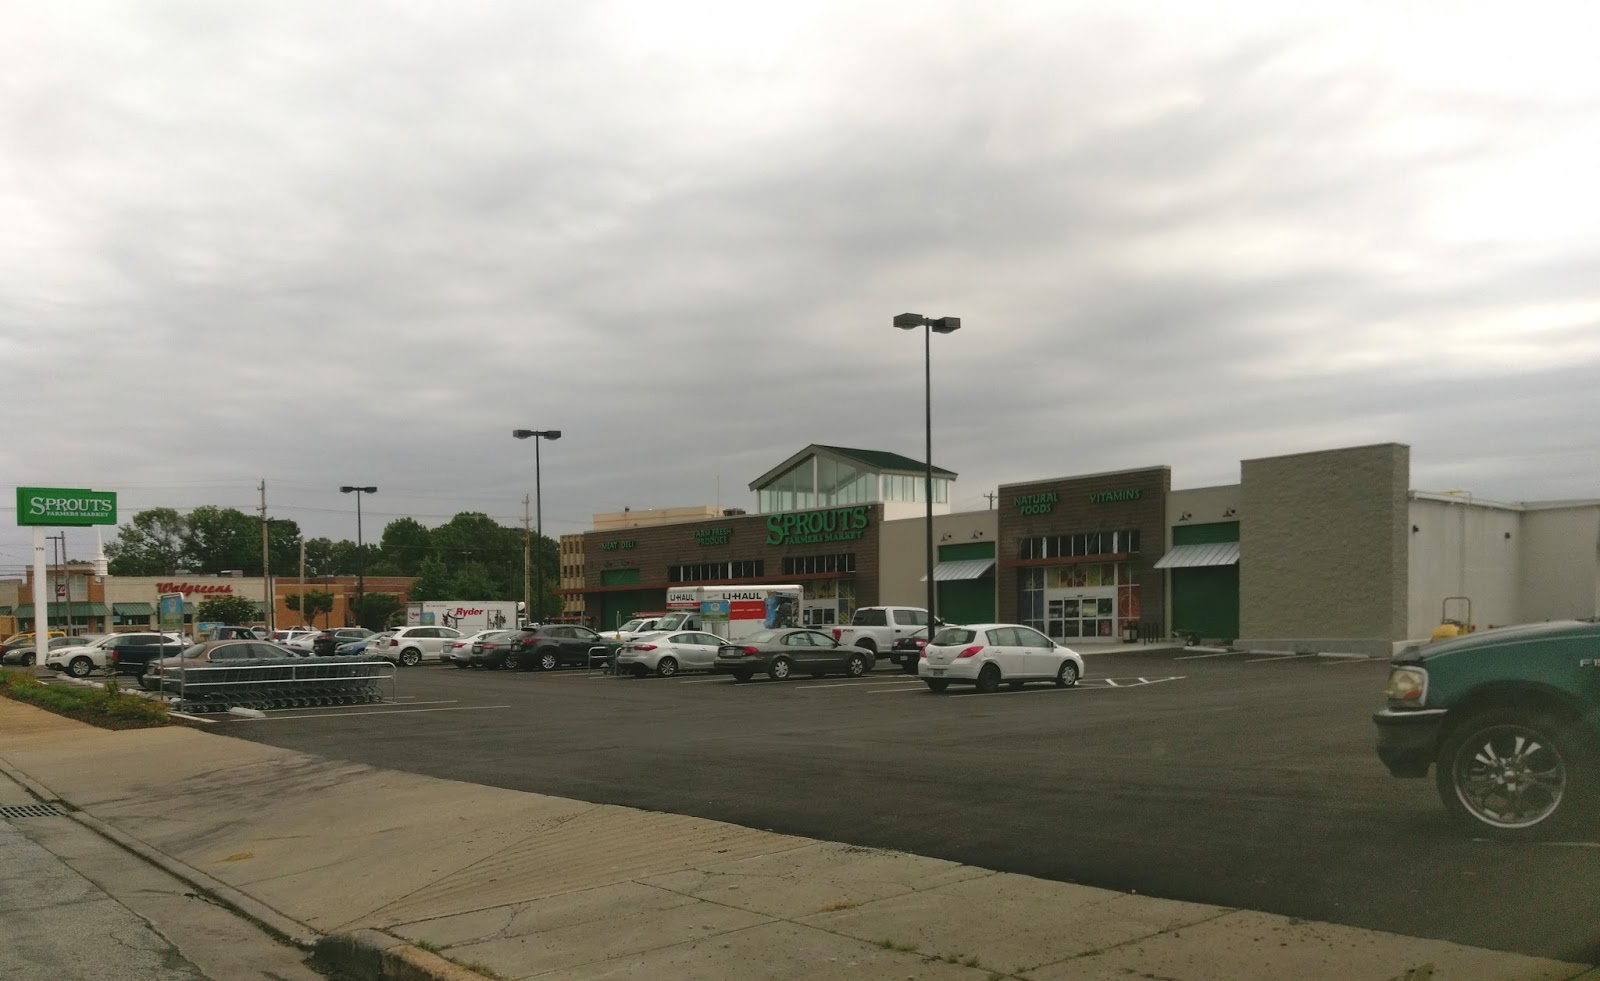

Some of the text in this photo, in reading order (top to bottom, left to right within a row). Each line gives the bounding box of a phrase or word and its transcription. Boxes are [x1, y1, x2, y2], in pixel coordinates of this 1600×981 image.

[1013, 493, 1058, 505] NATURAL
[1090, 489, 1140, 503] VITAMINS
[29, 496, 113, 515] SPROUTS
[1020, 504, 1051, 515] FOODS
[765, 507, 868, 545] SPROUTS
[824, 531, 863, 542] MARKET
[156, 582, 233, 596] Walgreens
[722, 592, 762, 600] U-HAUL
[456, 608, 484, 617] Ryder
